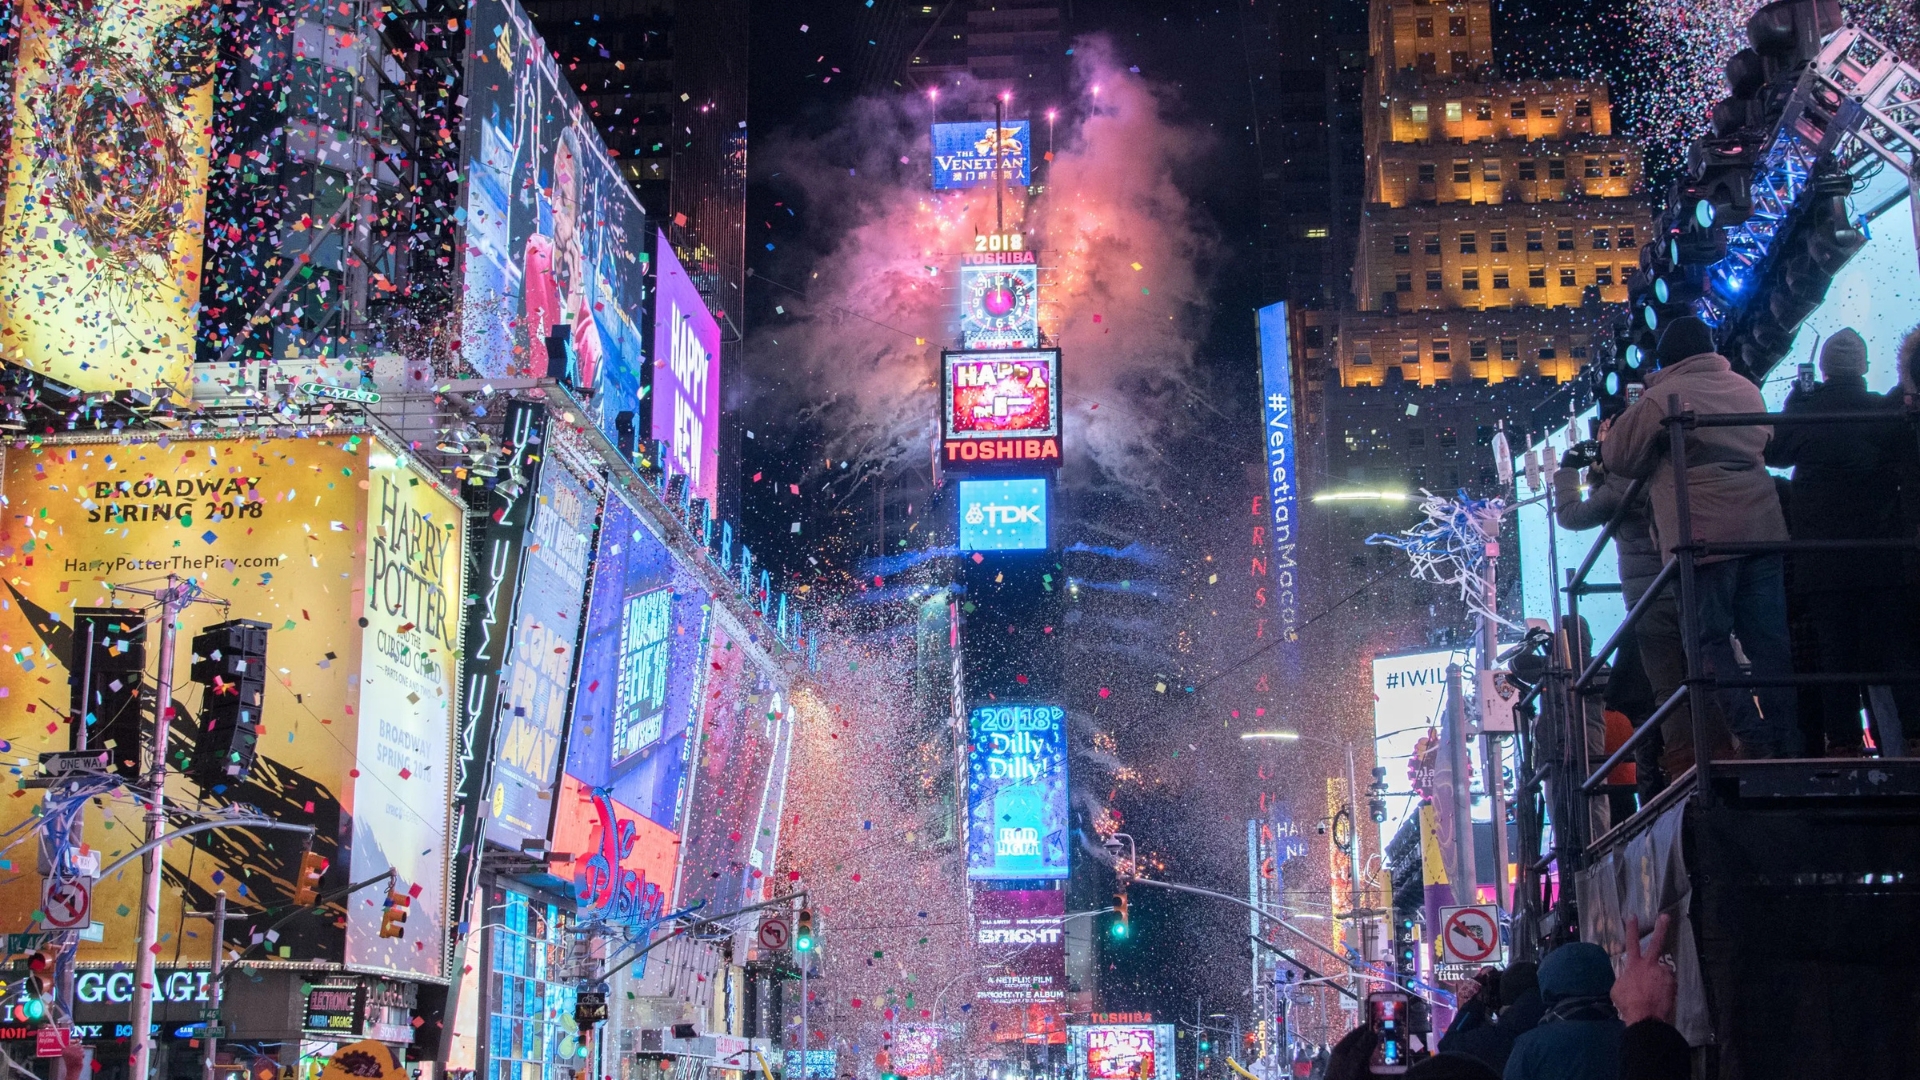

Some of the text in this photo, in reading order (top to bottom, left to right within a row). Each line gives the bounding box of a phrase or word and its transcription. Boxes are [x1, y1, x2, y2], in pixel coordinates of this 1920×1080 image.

[935, 156, 1024, 171] VENETAN
[975, 234, 1022, 251] 2018
[963, 251, 1035, 265] TOSHIBA
[671, 301, 709, 418] HAPPY
[674, 388, 703, 488] NEW
[945, 439, 1058, 461] TOSHIBA
[95, 477, 262, 499] BROADWAY
[87, 501, 263, 523] SPRING 2018
[983, 505, 1041, 524] TDK
[381, 475, 451, 588] HARRY
[370, 537, 452, 651] POTTER
[377, 628, 411, 668] CURSED
[519, 612, 571, 692] COME
[509, 660, 565, 736] FROM
[981, 708, 1051, 731] 2018
[379, 718, 432, 760] BROADWAY
[501, 716, 558, 784] AWAY
[990, 731, 1044, 760] Dilly
[60, 757, 103, 770] ONE WAY
[376, 742, 410, 771] SPRING
[987, 755, 1048, 784] Dilly!
[1277, 821, 1304, 838] HA
[978, 928, 1061, 943] BRIGHT
[995, 976, 1031, 984] NETFLIX
[1033, 976, 1053, 984] FILM
[1091, 1012, 1153, 1023] TOSHIBA
